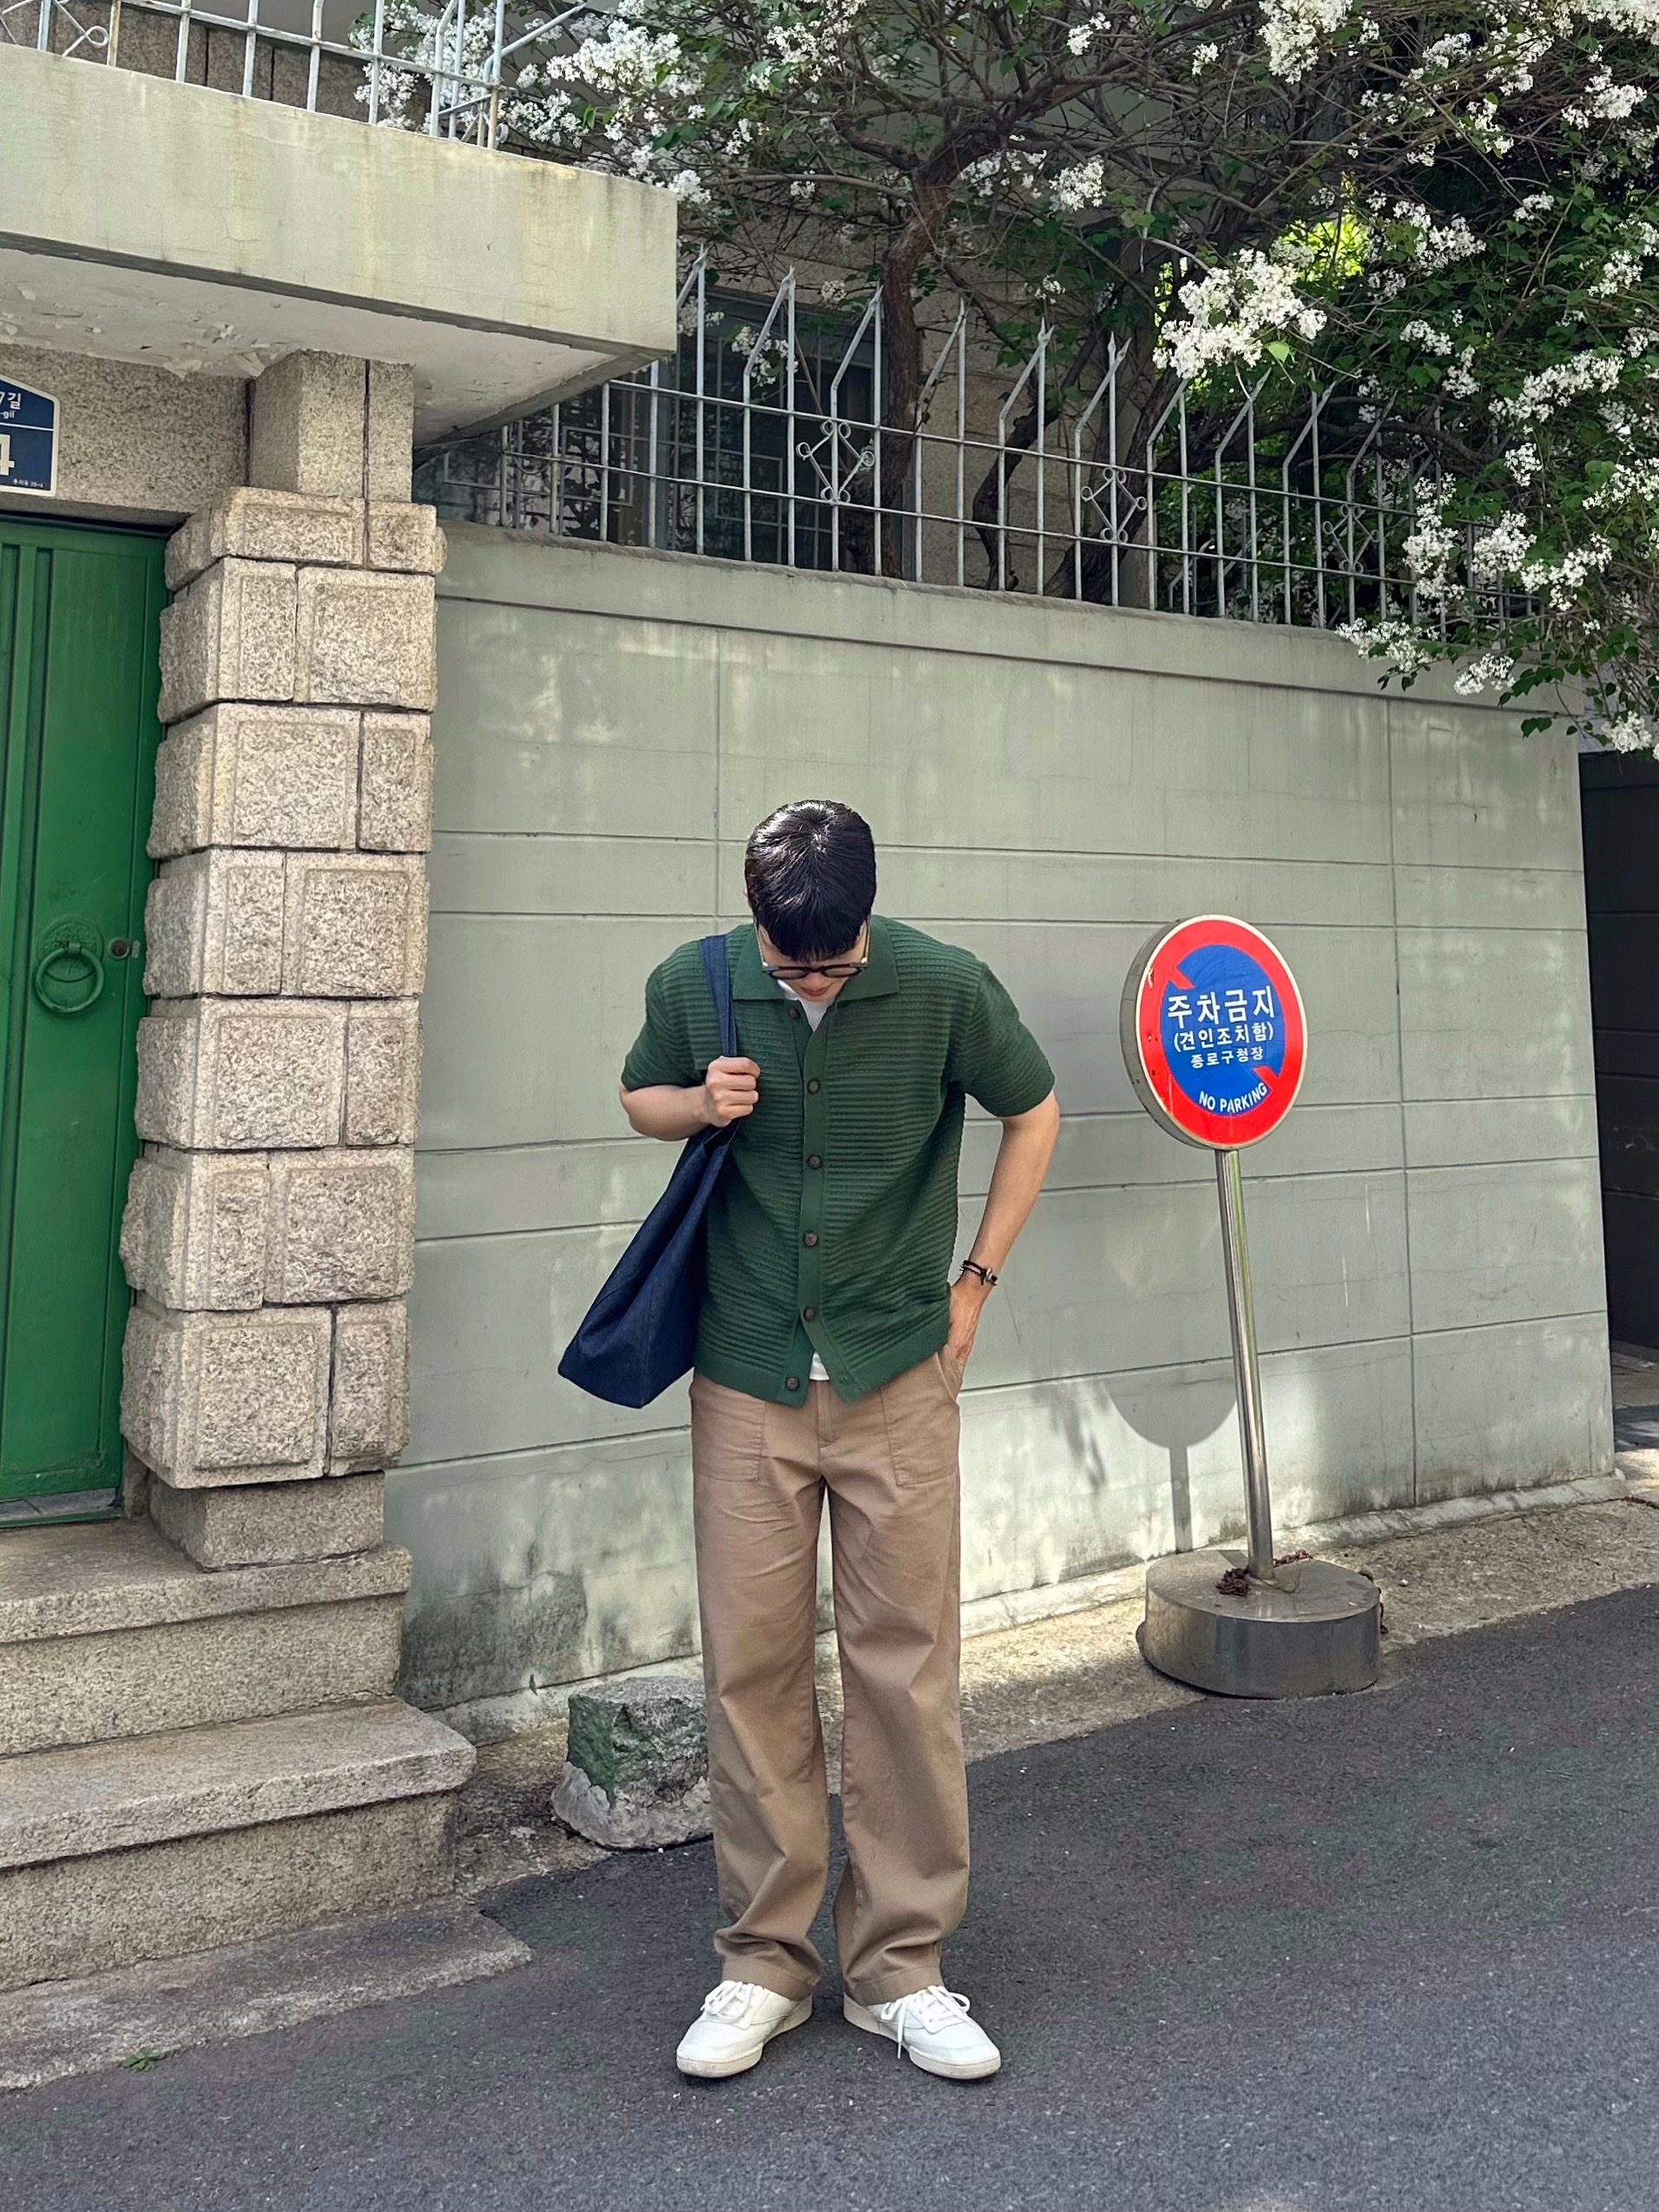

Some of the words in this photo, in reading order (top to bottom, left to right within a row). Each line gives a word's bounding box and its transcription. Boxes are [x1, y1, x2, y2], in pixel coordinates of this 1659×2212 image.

[1168, 985, 1275, 1029] 주차금지
[1173, 1021, 1274, 1052] (견인조치함)
[1190, 1045, 1264, 1069] 종로구청장
[1198, 1090, 1215, 1111] NO
[1220, 1082, 1268, 1114] PARKING
